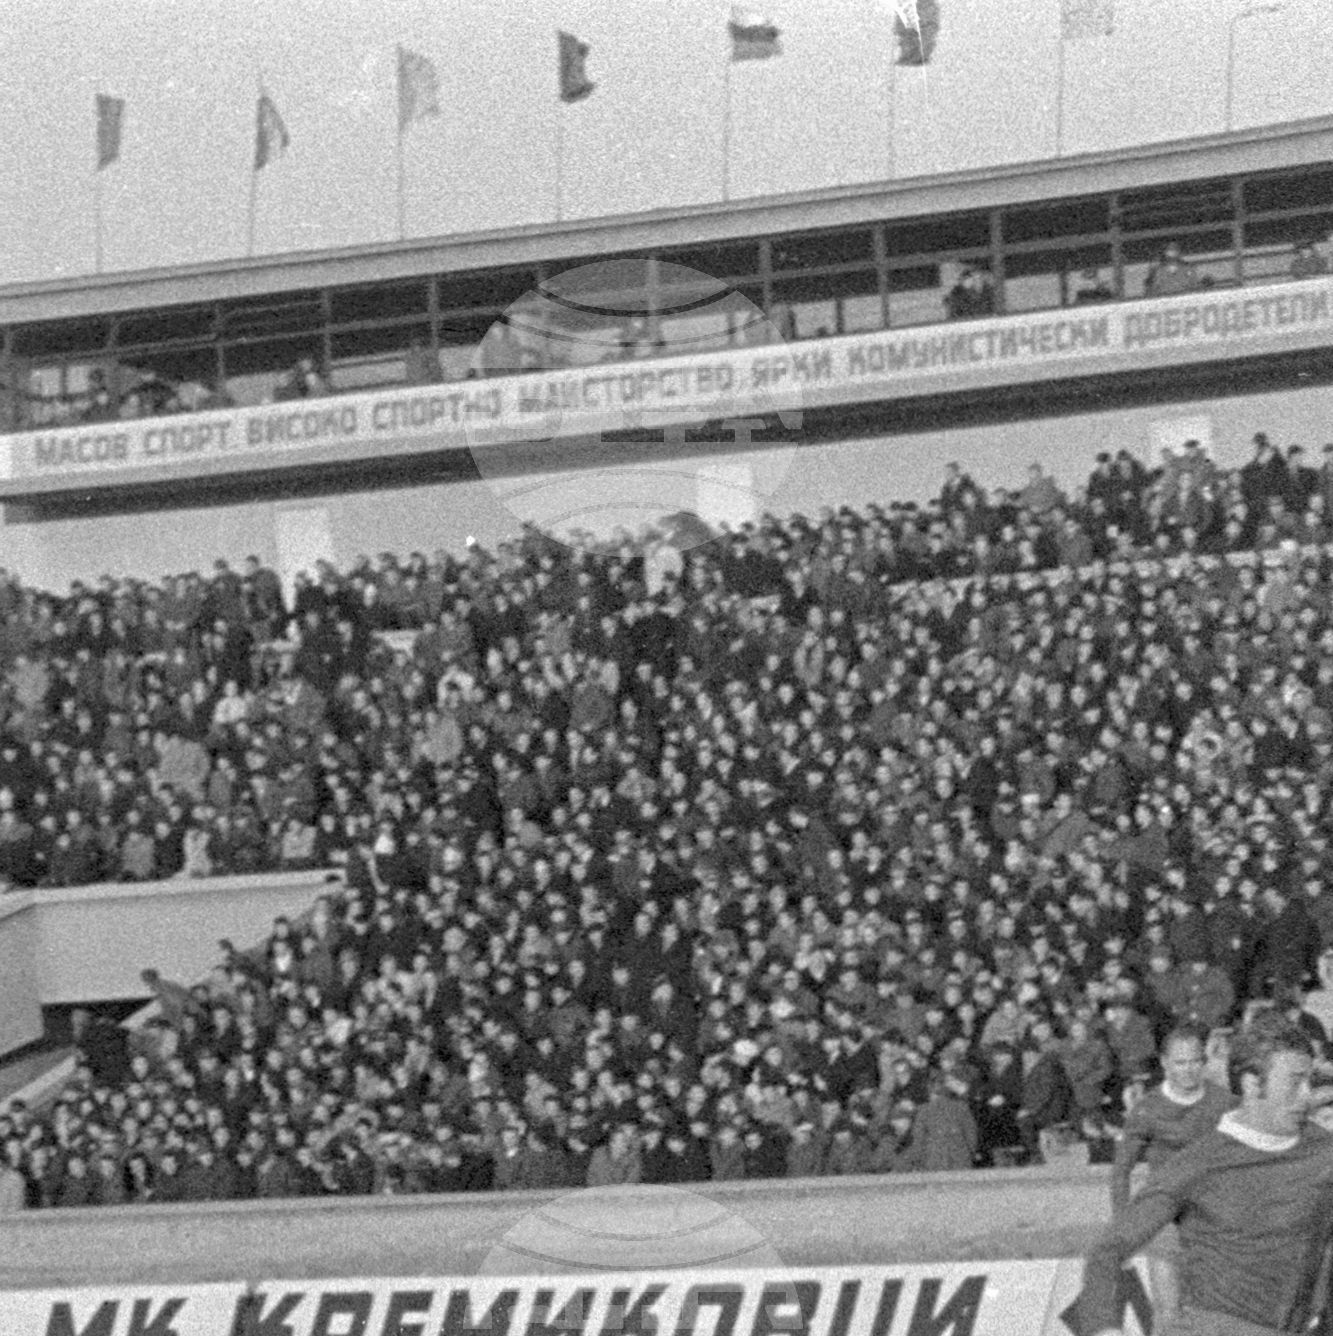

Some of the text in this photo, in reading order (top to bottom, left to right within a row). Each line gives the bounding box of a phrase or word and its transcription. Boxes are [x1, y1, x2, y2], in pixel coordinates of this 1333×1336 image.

[35, 435, 128, 466] МАСОВ
[143, 422, 230, 456] СПОРТ
[246, 407, 358, 446] ВИСОКО
[751, 347, 832, 388] ЯРКИ
[848, 318, 1110, 375] КОМУНИСТИЧЕСКИ
